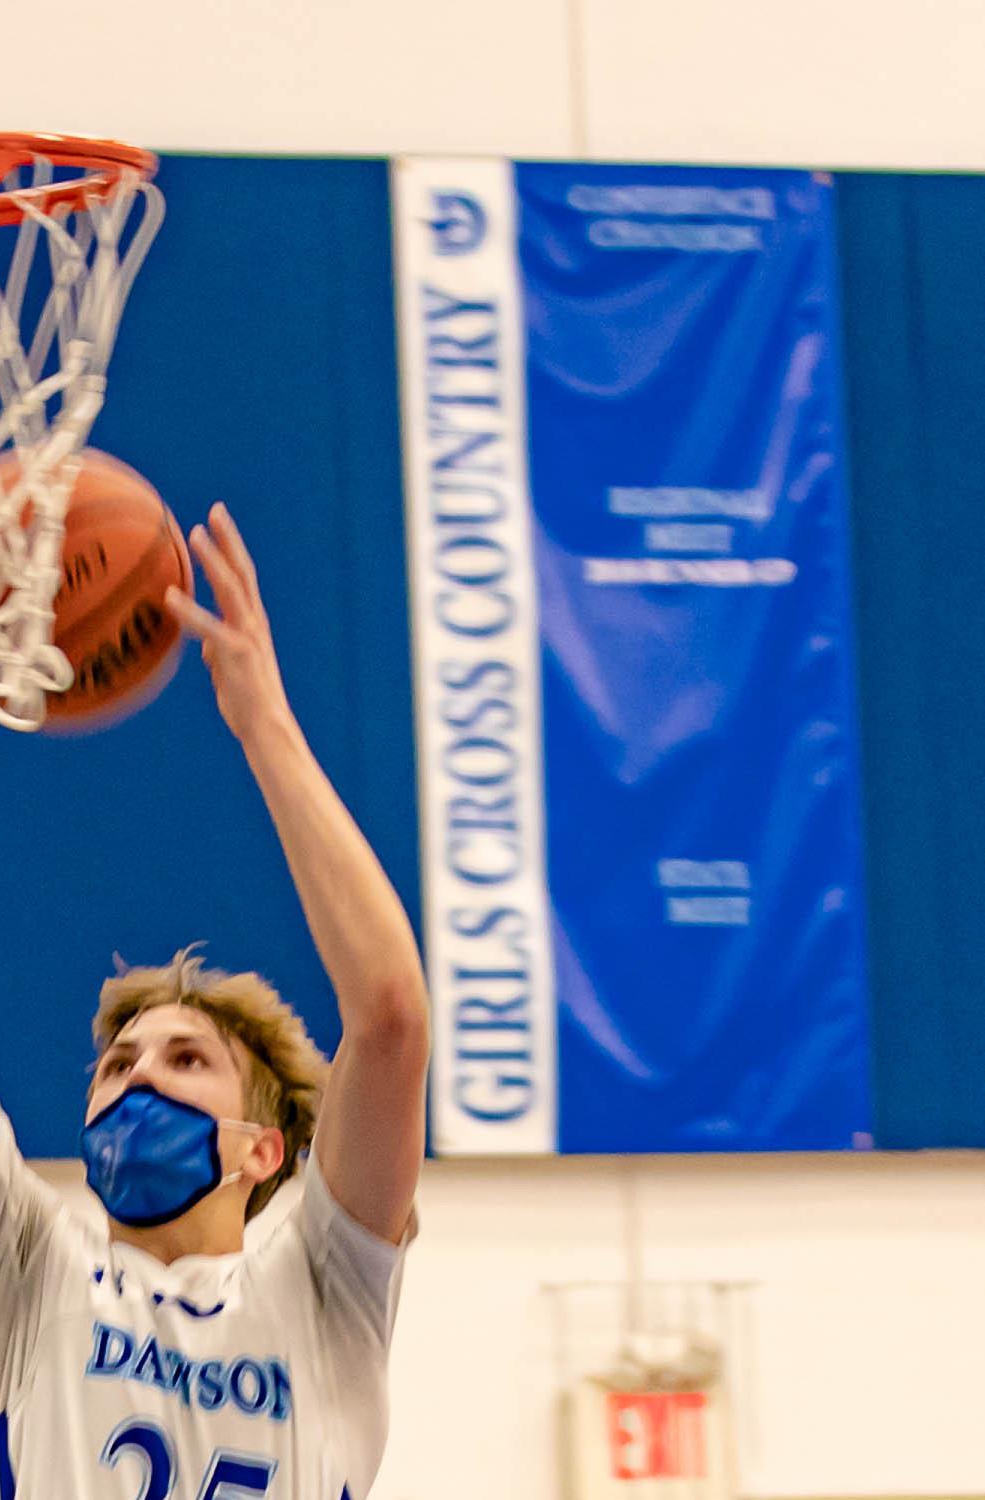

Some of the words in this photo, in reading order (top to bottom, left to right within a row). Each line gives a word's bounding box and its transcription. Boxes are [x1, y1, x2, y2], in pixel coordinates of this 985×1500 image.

[424, 286, 513, 640] COUNTRY
[442, 658, 521, 885] CROSS
[451, 906, 533, 1122] GIRLS
